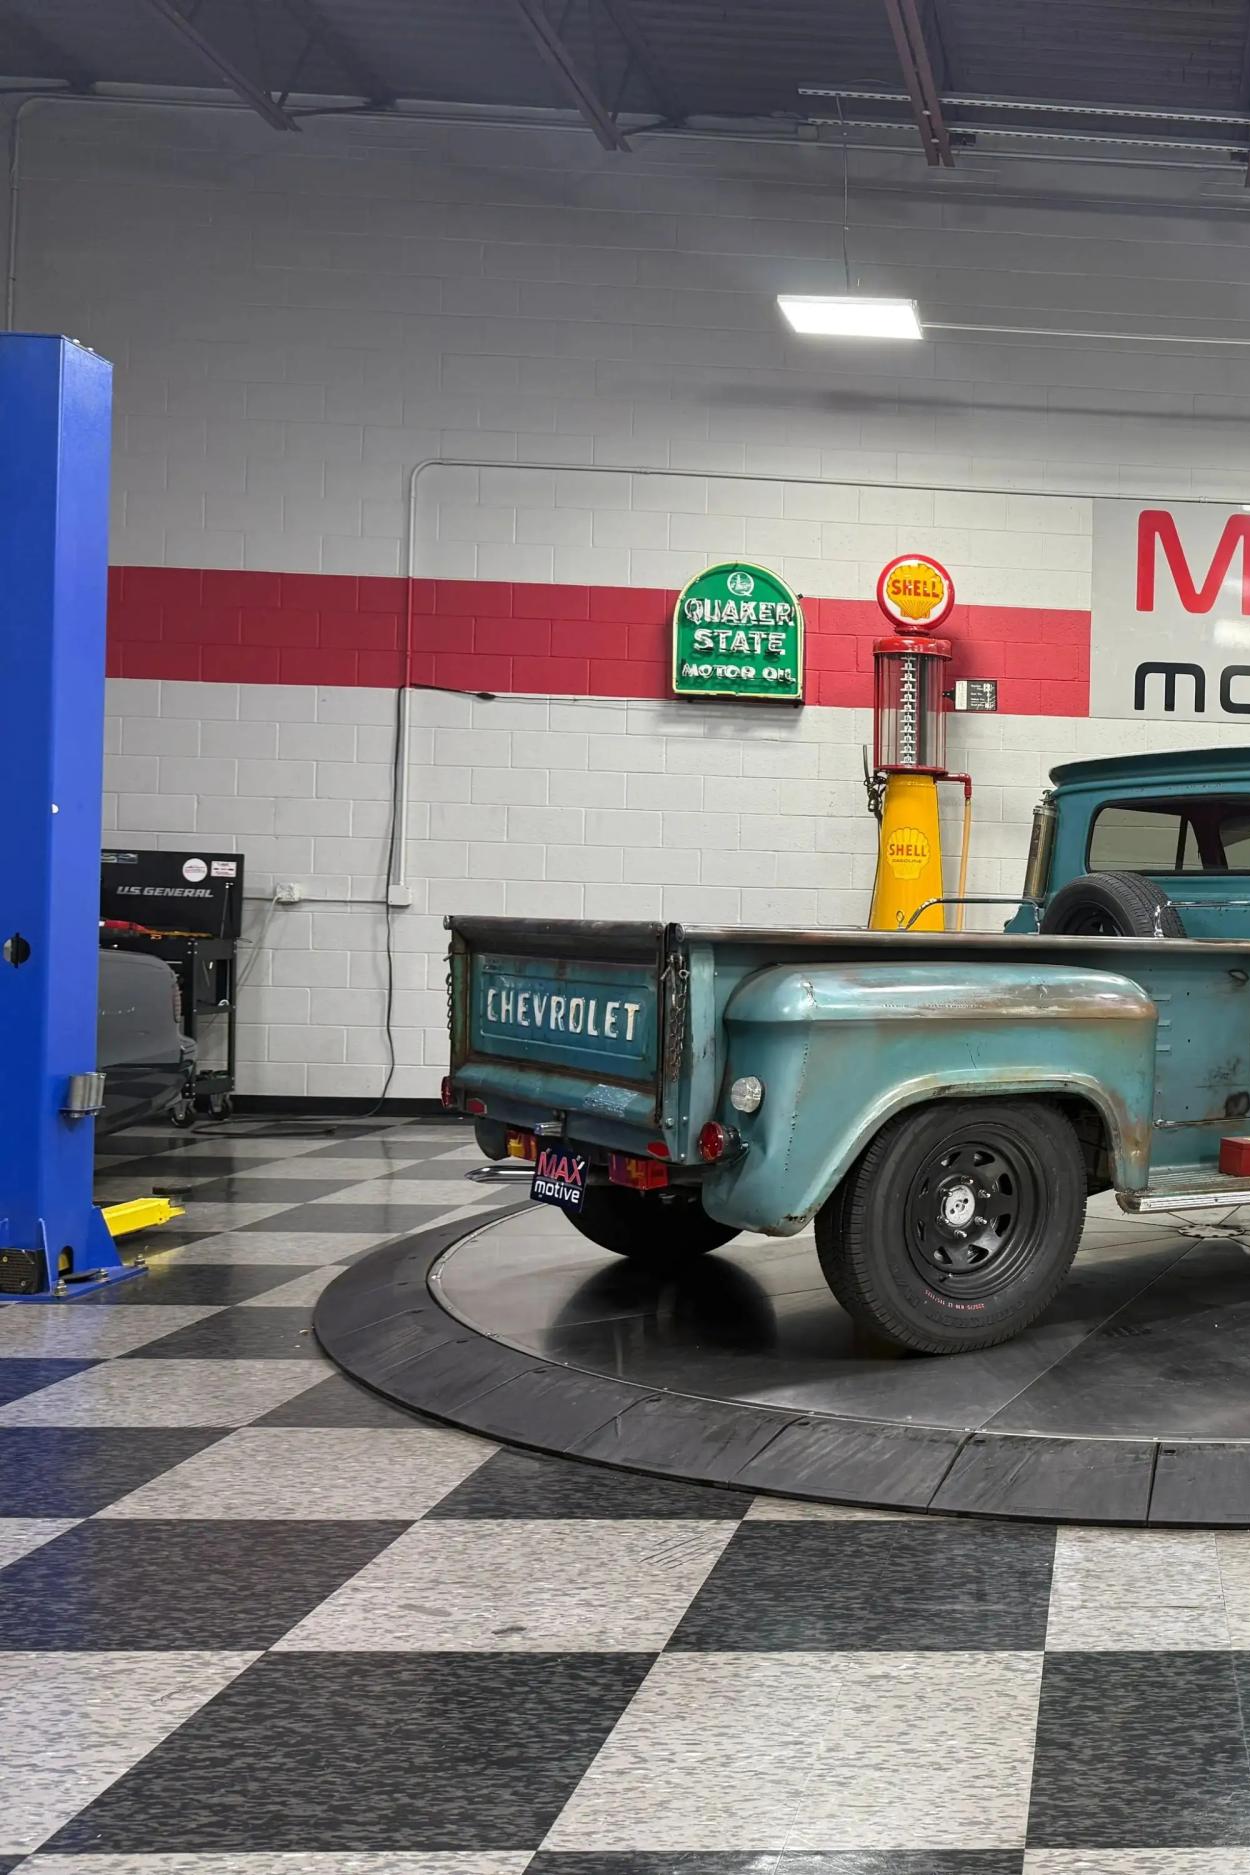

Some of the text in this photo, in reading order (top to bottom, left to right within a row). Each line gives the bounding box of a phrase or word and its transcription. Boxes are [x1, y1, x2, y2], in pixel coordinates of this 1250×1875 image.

[891, 579, 940, 598] SHELL
[684, 598, 795, 626] QUAKER
[693, 629, 786, 655] STATE
[681, 662, 796, 683] MOTOR OIL
[889, 844, 927, 857] SHELL
[143, 887, 214, 898] GENERAL
[486, 988, 641, 1041] CHEVROLET
[537, 1151, 585, 1186] MAX
[534, 1180, 580, 1204] motive
